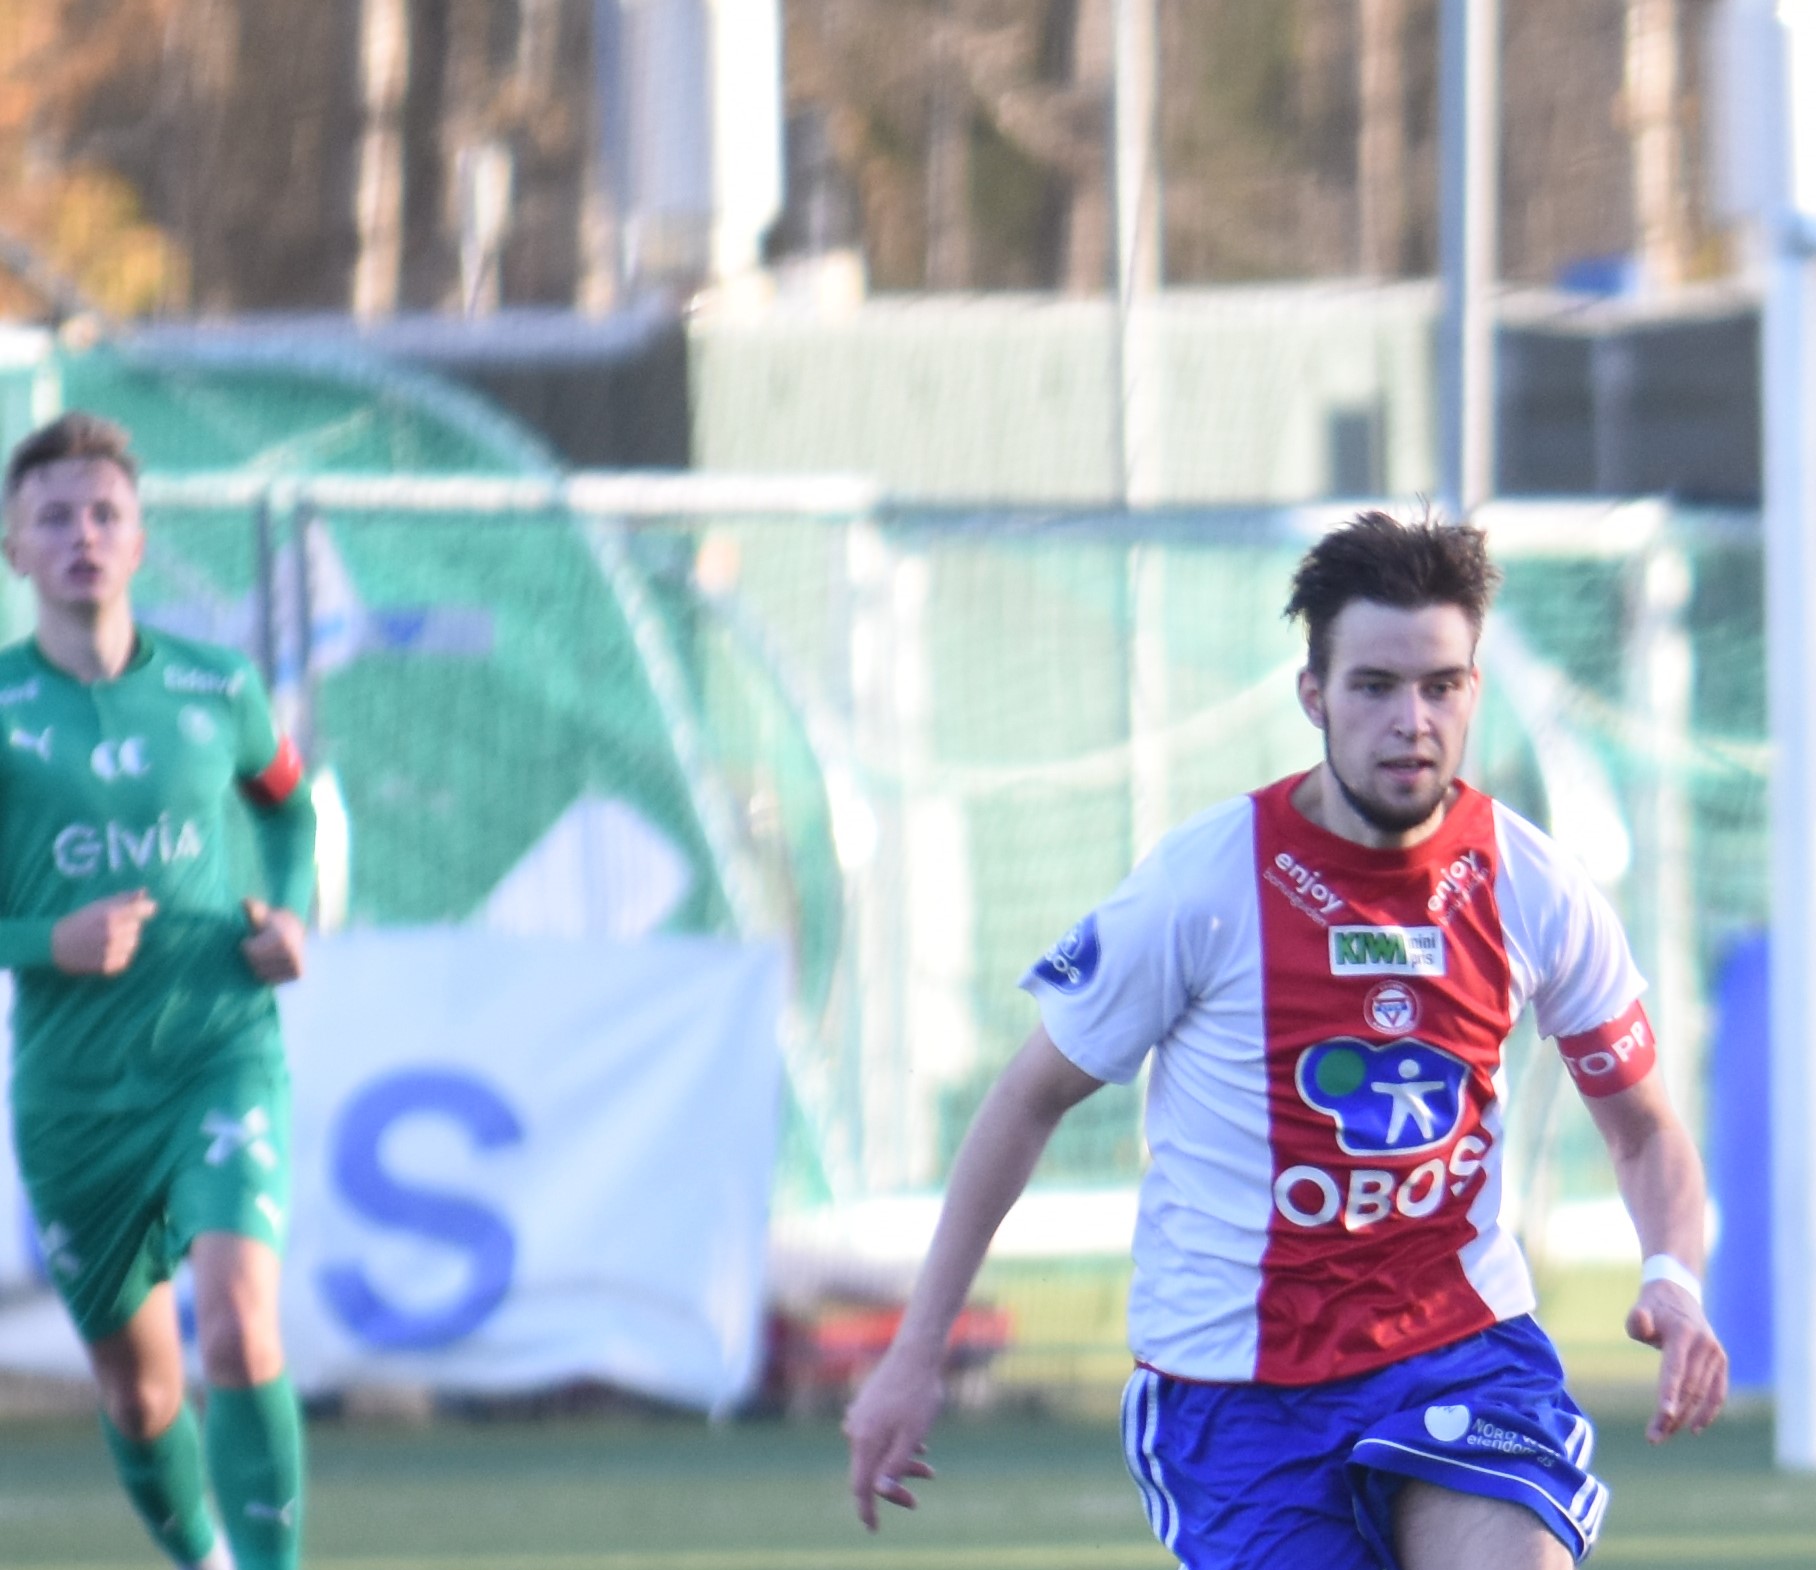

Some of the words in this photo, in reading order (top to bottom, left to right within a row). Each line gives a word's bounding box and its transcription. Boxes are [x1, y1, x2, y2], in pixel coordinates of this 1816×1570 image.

[1274, 852, 1344, 914] enjoy
[1427, 849, 1478, 912] enjoy
[1334, 931, 1408, 966] KIWI
[1274, 1135, 1488, 1231] OBOS
